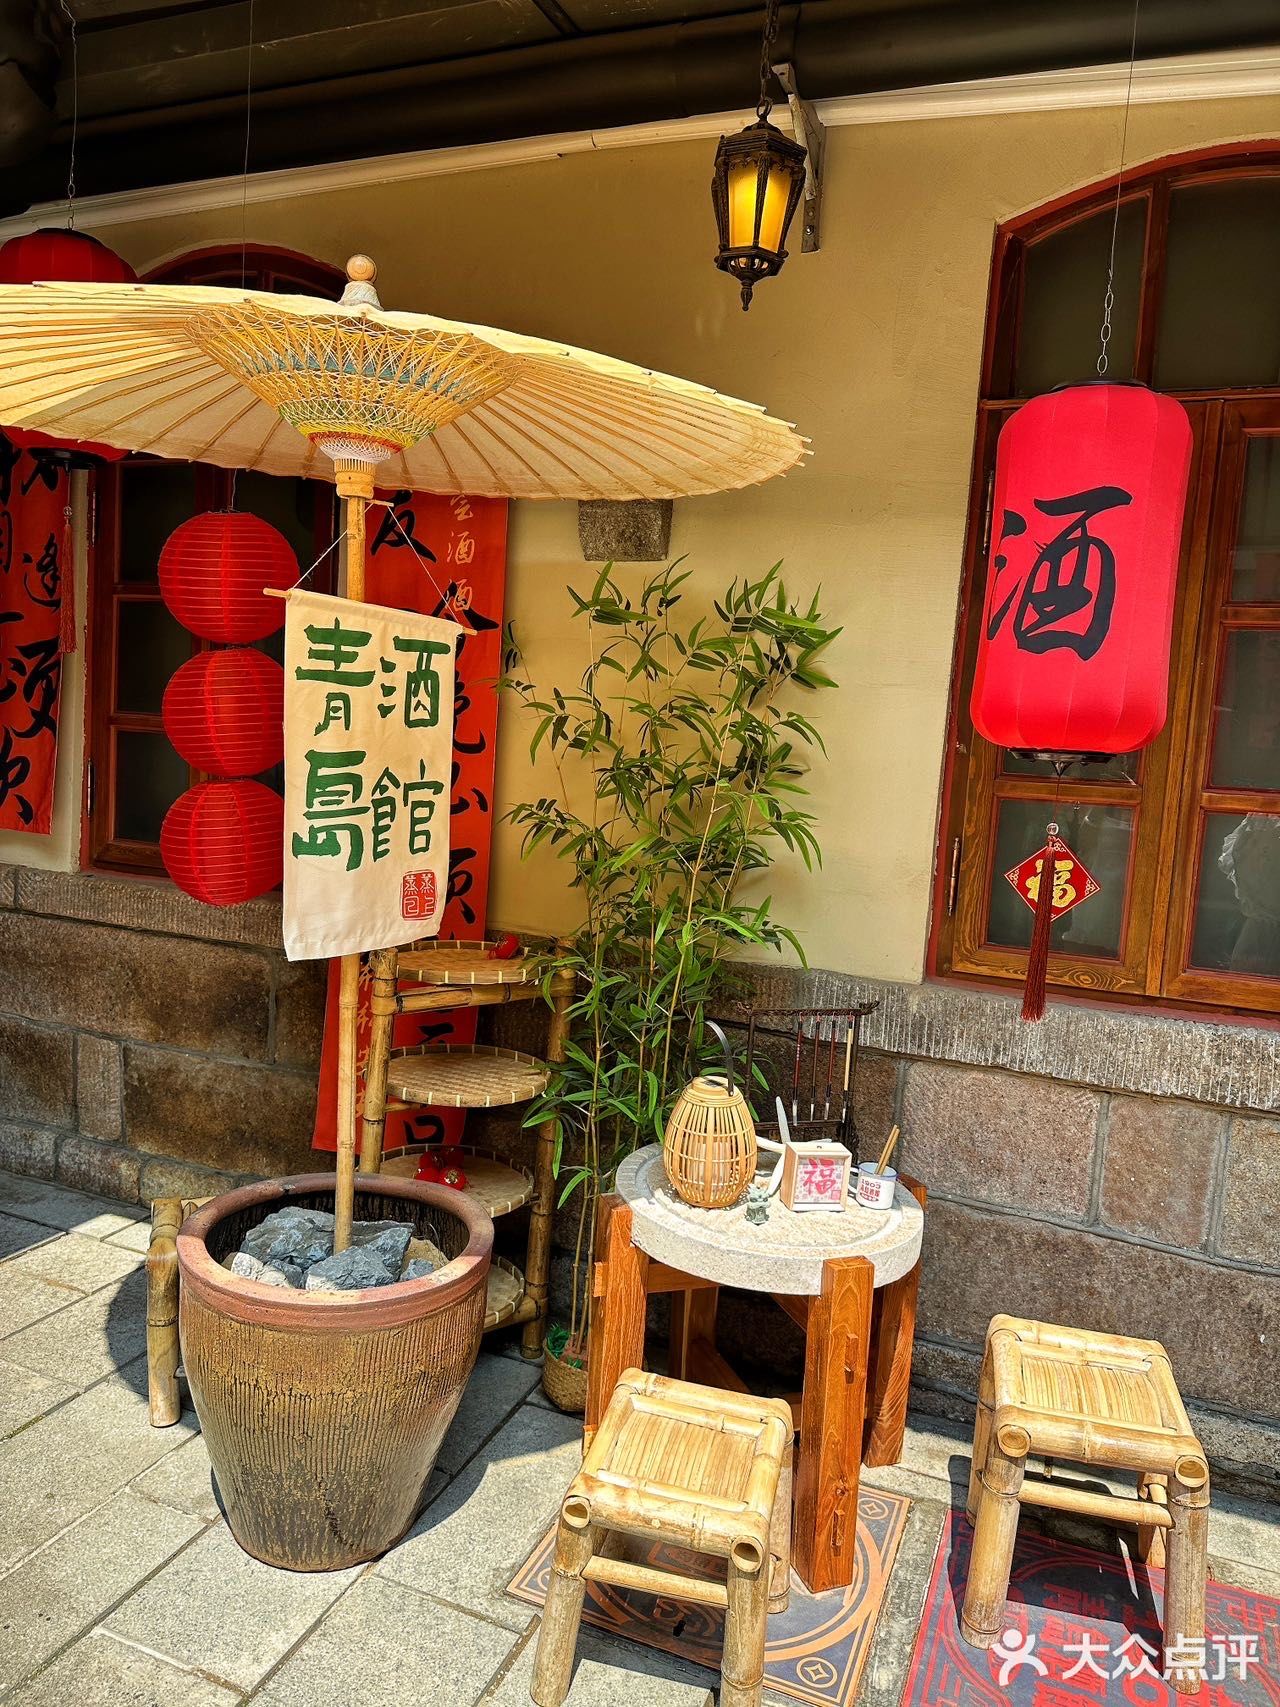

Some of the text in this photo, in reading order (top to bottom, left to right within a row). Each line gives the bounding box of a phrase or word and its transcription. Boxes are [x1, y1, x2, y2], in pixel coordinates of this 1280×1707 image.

[987, 485, 1133, 662] 酒
[291, 617, 376, 872] 青島
[371, 635, 452, 863] 酒館
[1025, 859, 1077, 908] 福
[802, 1157, 836, 1195] 福
